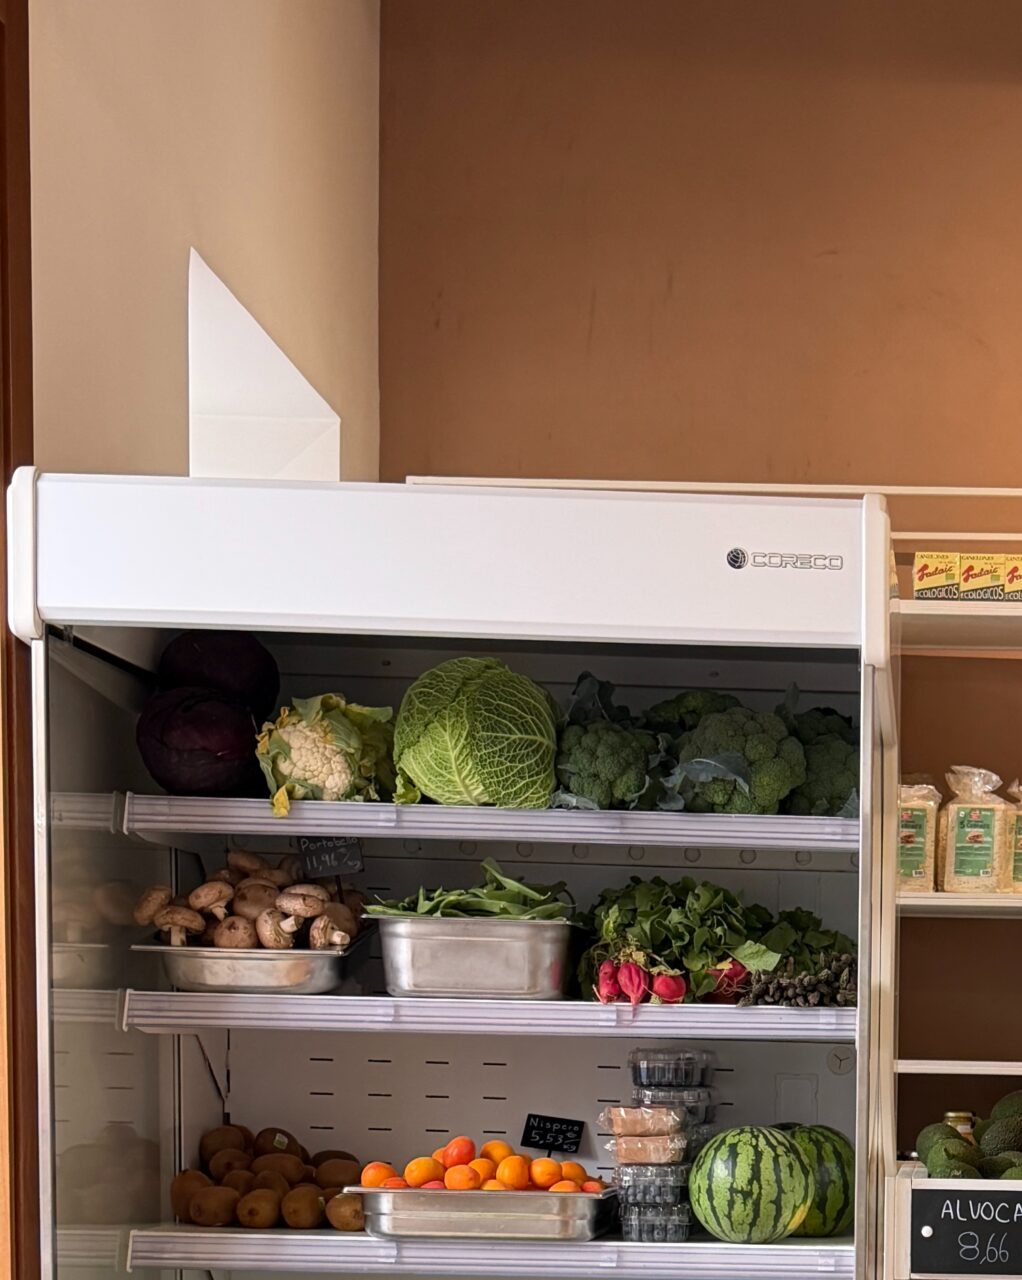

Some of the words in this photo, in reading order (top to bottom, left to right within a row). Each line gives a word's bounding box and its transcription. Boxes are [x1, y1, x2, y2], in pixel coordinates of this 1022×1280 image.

[751, 552, 843, 570] CORECO
[530, 1117, 579, 1131] Nispero
[530, 1130, 564, 1145] 5,53
[958, 1232, 1009, 1264] 8,66
